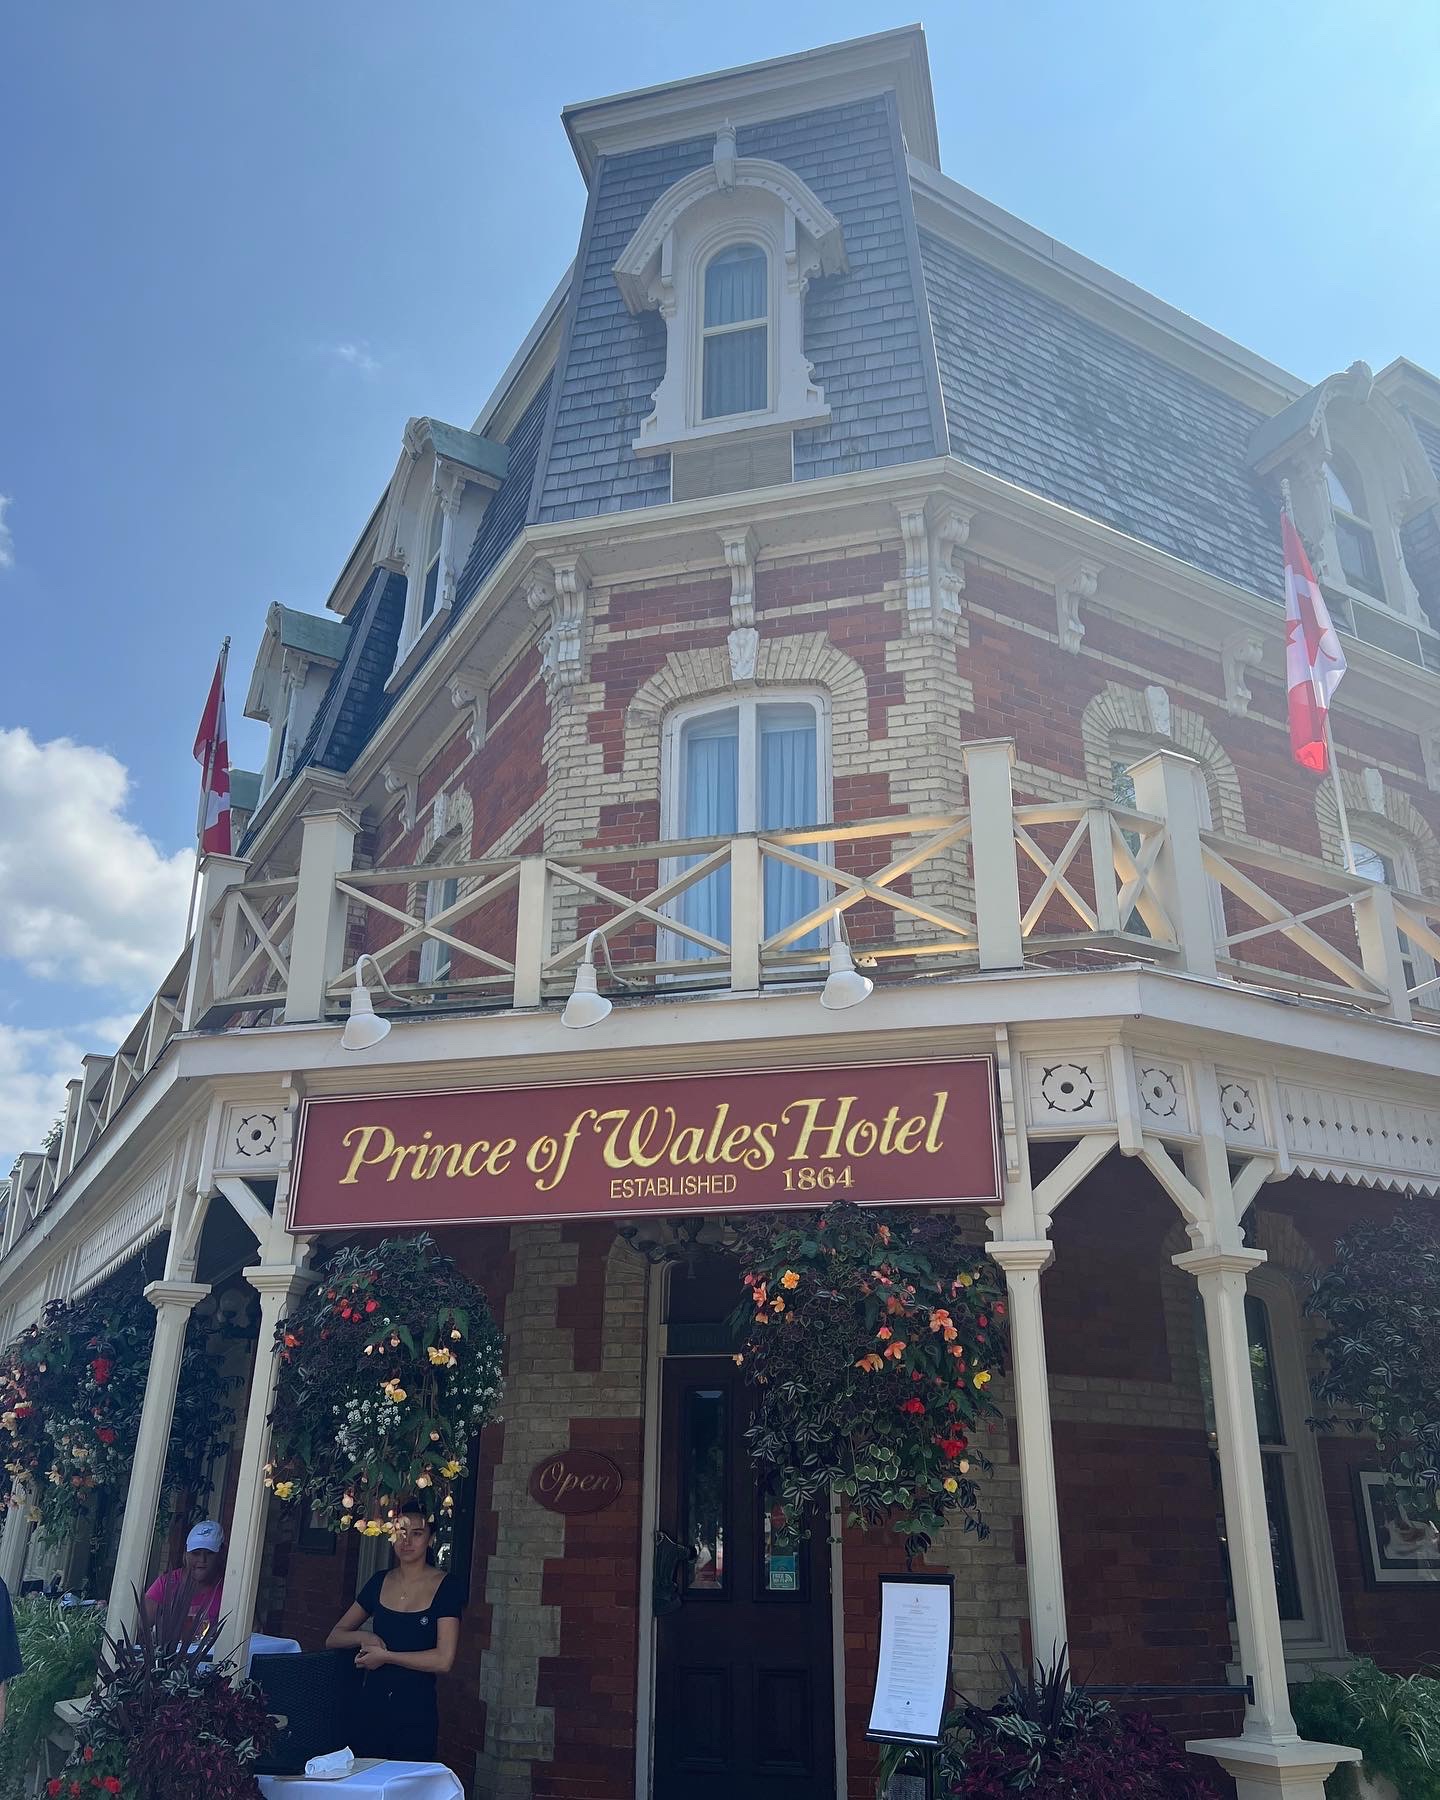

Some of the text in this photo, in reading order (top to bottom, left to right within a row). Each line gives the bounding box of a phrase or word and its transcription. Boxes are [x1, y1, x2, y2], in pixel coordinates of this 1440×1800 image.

[338, 1090, 949, 1192] Prince of Wales Hotel
[609, 1165, 855, 1199] ESTABLISHED 1864
[539, 1461, 611, 1504] Open
